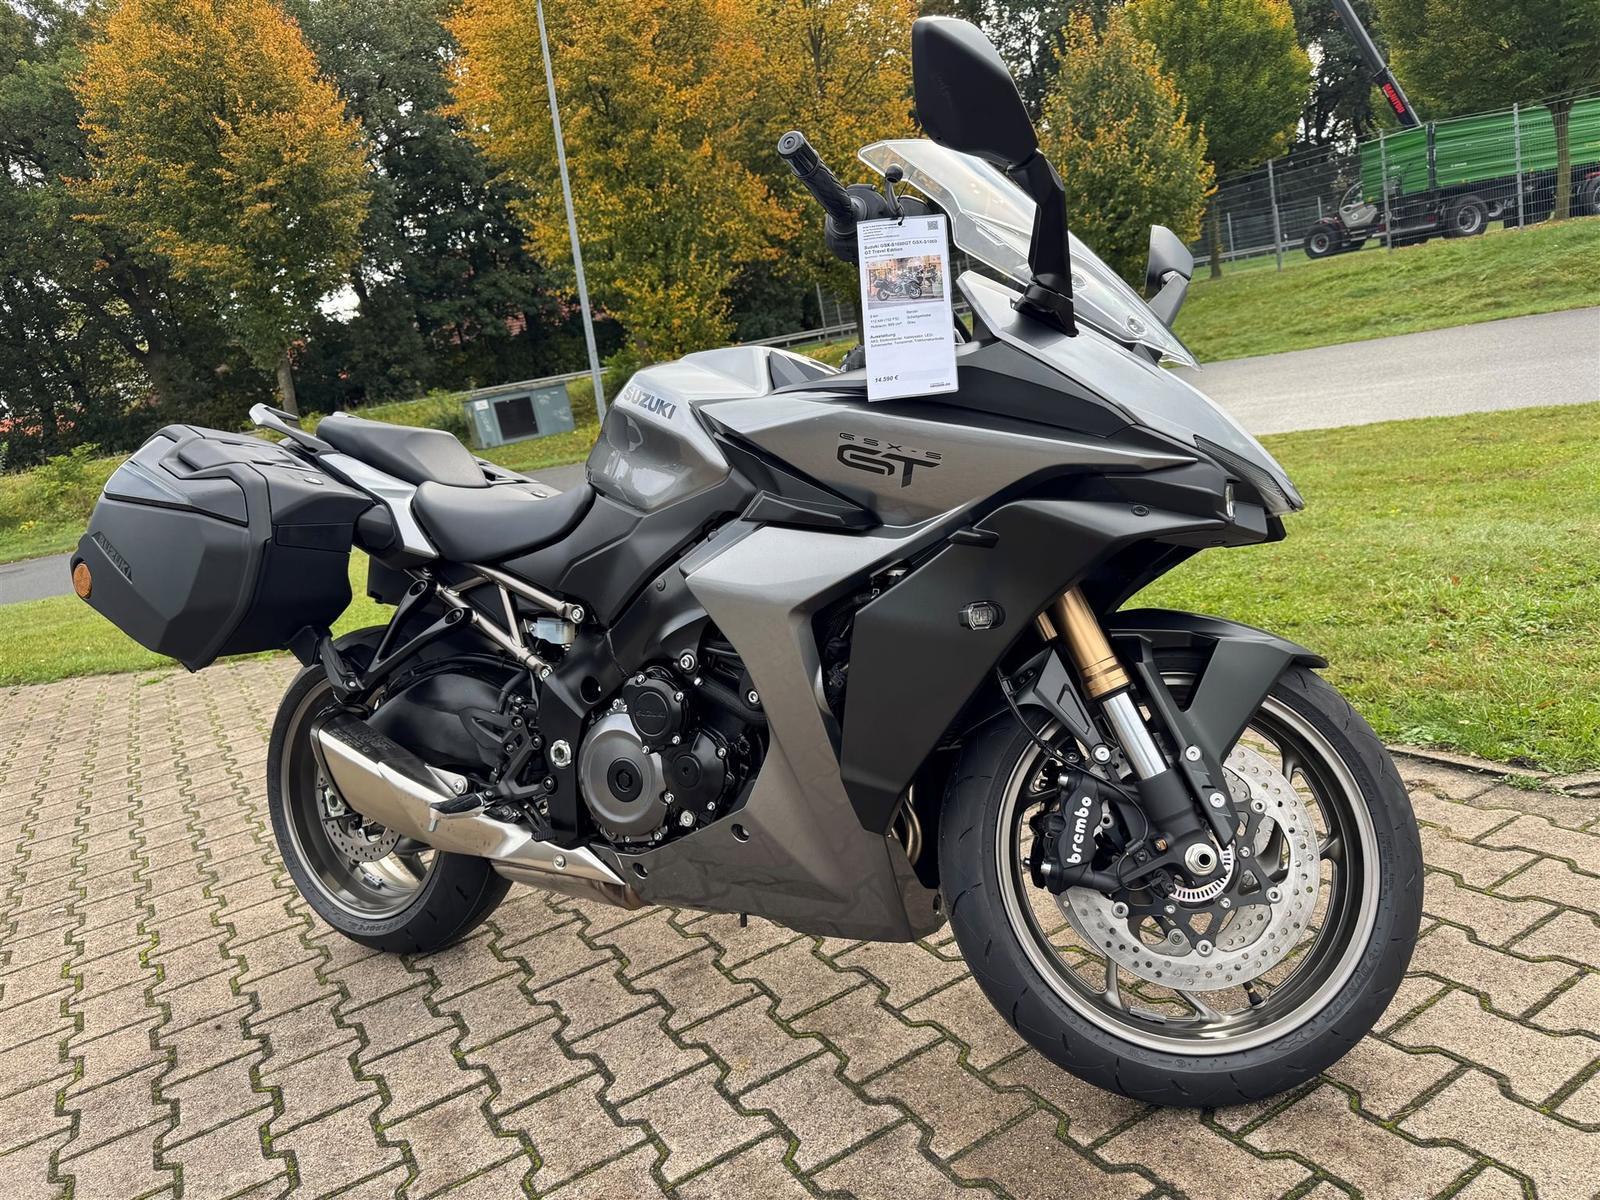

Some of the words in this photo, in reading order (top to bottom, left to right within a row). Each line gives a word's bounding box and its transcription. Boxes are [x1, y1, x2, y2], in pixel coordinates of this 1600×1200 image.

[1382, 82, 1406, 113] MANITOU
[623, 385, 677, 420] SUZUKI
[837, 444, 941, 488] GT
[1066, 796, 1092, 864] brembo
